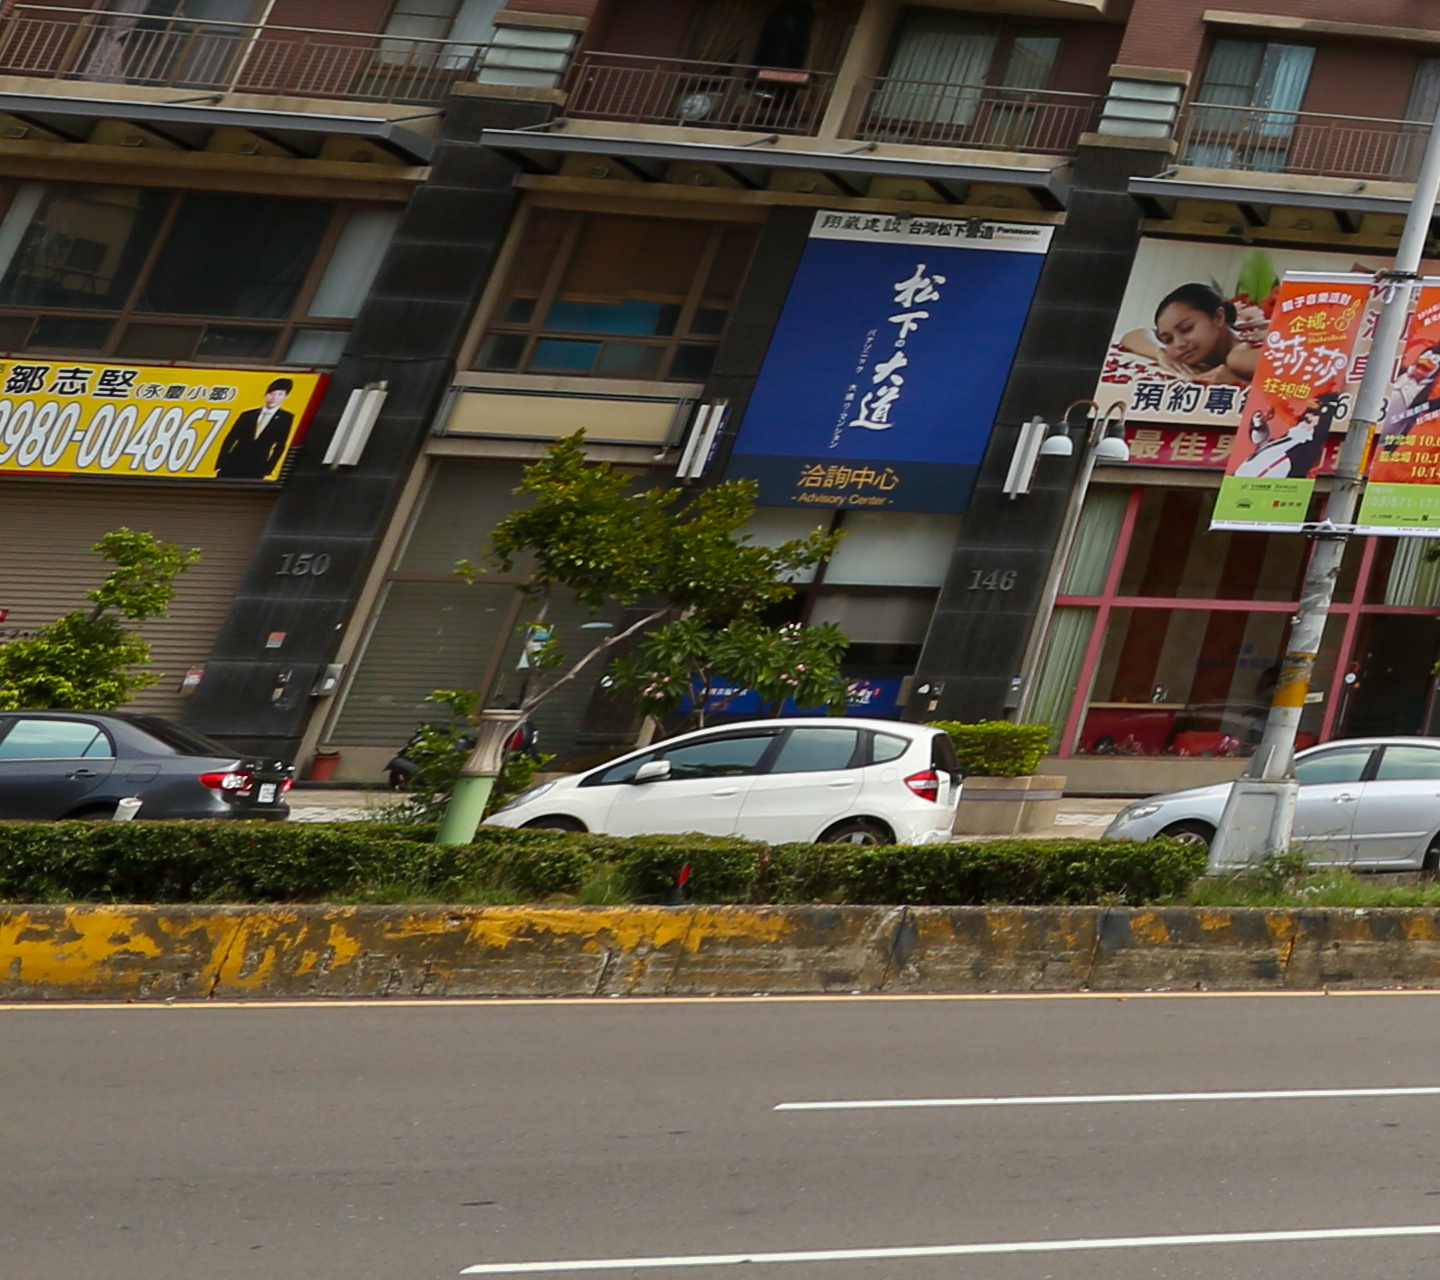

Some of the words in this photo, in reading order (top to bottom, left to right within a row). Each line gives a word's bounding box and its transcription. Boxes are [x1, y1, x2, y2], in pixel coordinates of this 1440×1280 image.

[5, 364, 139, 399] 鄒志堅
[1130, 381, 1251, 418] 預約專
[796, 464, 900, 491] 洽詢中心
[798, 491, 849, 507] Advisory
[848, 493, 888, 506] Center
[275, 552, 332, 577] 150
[967, 569, 1018, 592] 146
